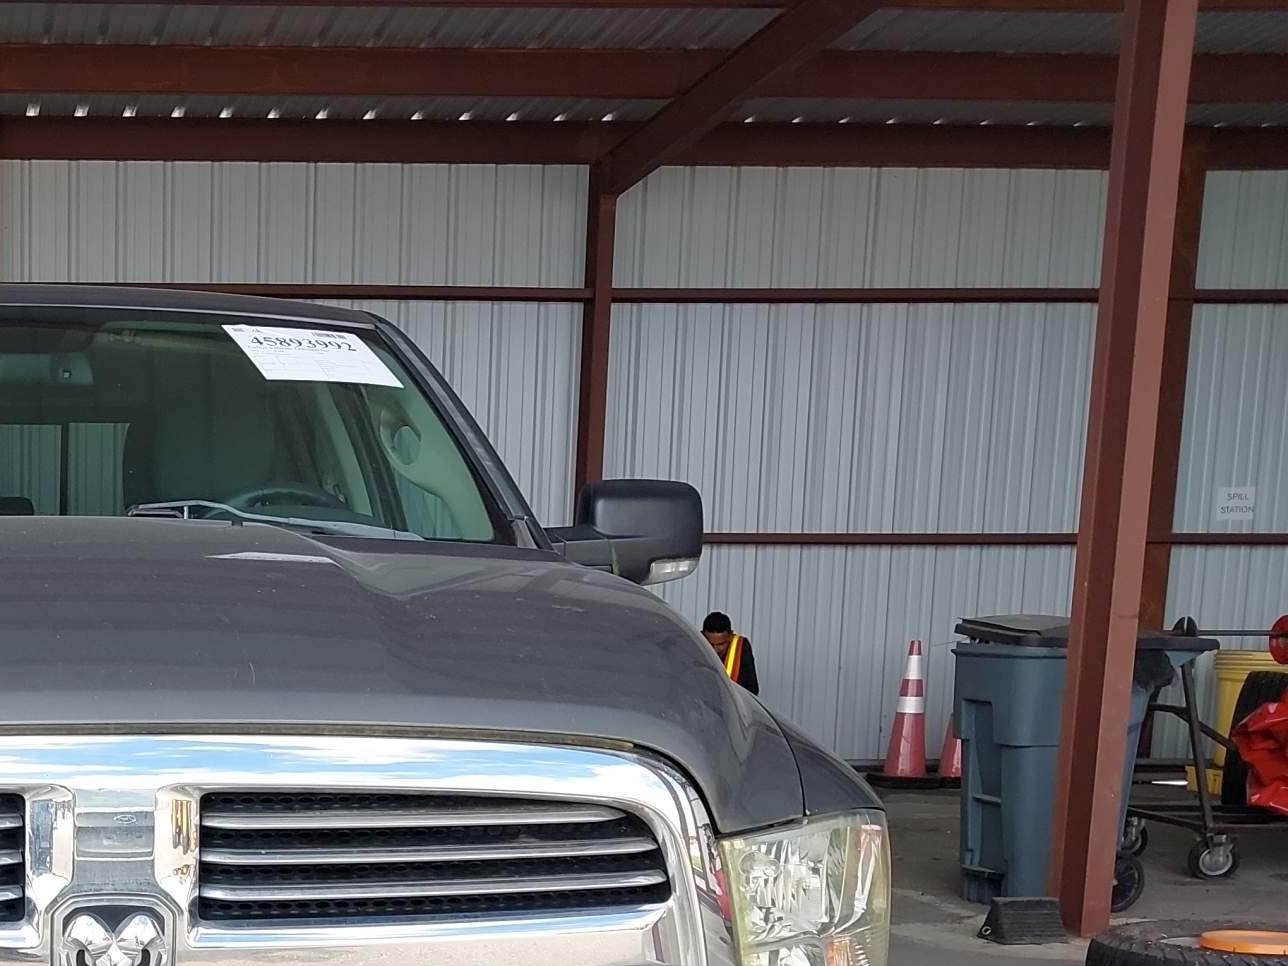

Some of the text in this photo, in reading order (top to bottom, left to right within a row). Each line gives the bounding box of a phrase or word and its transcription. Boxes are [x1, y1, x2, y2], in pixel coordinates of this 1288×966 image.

[251, 335, 357, 353] 45893992
[1227, 493, 1249, 501] SPILL
[1220, 505, 1256, 514] STATION
